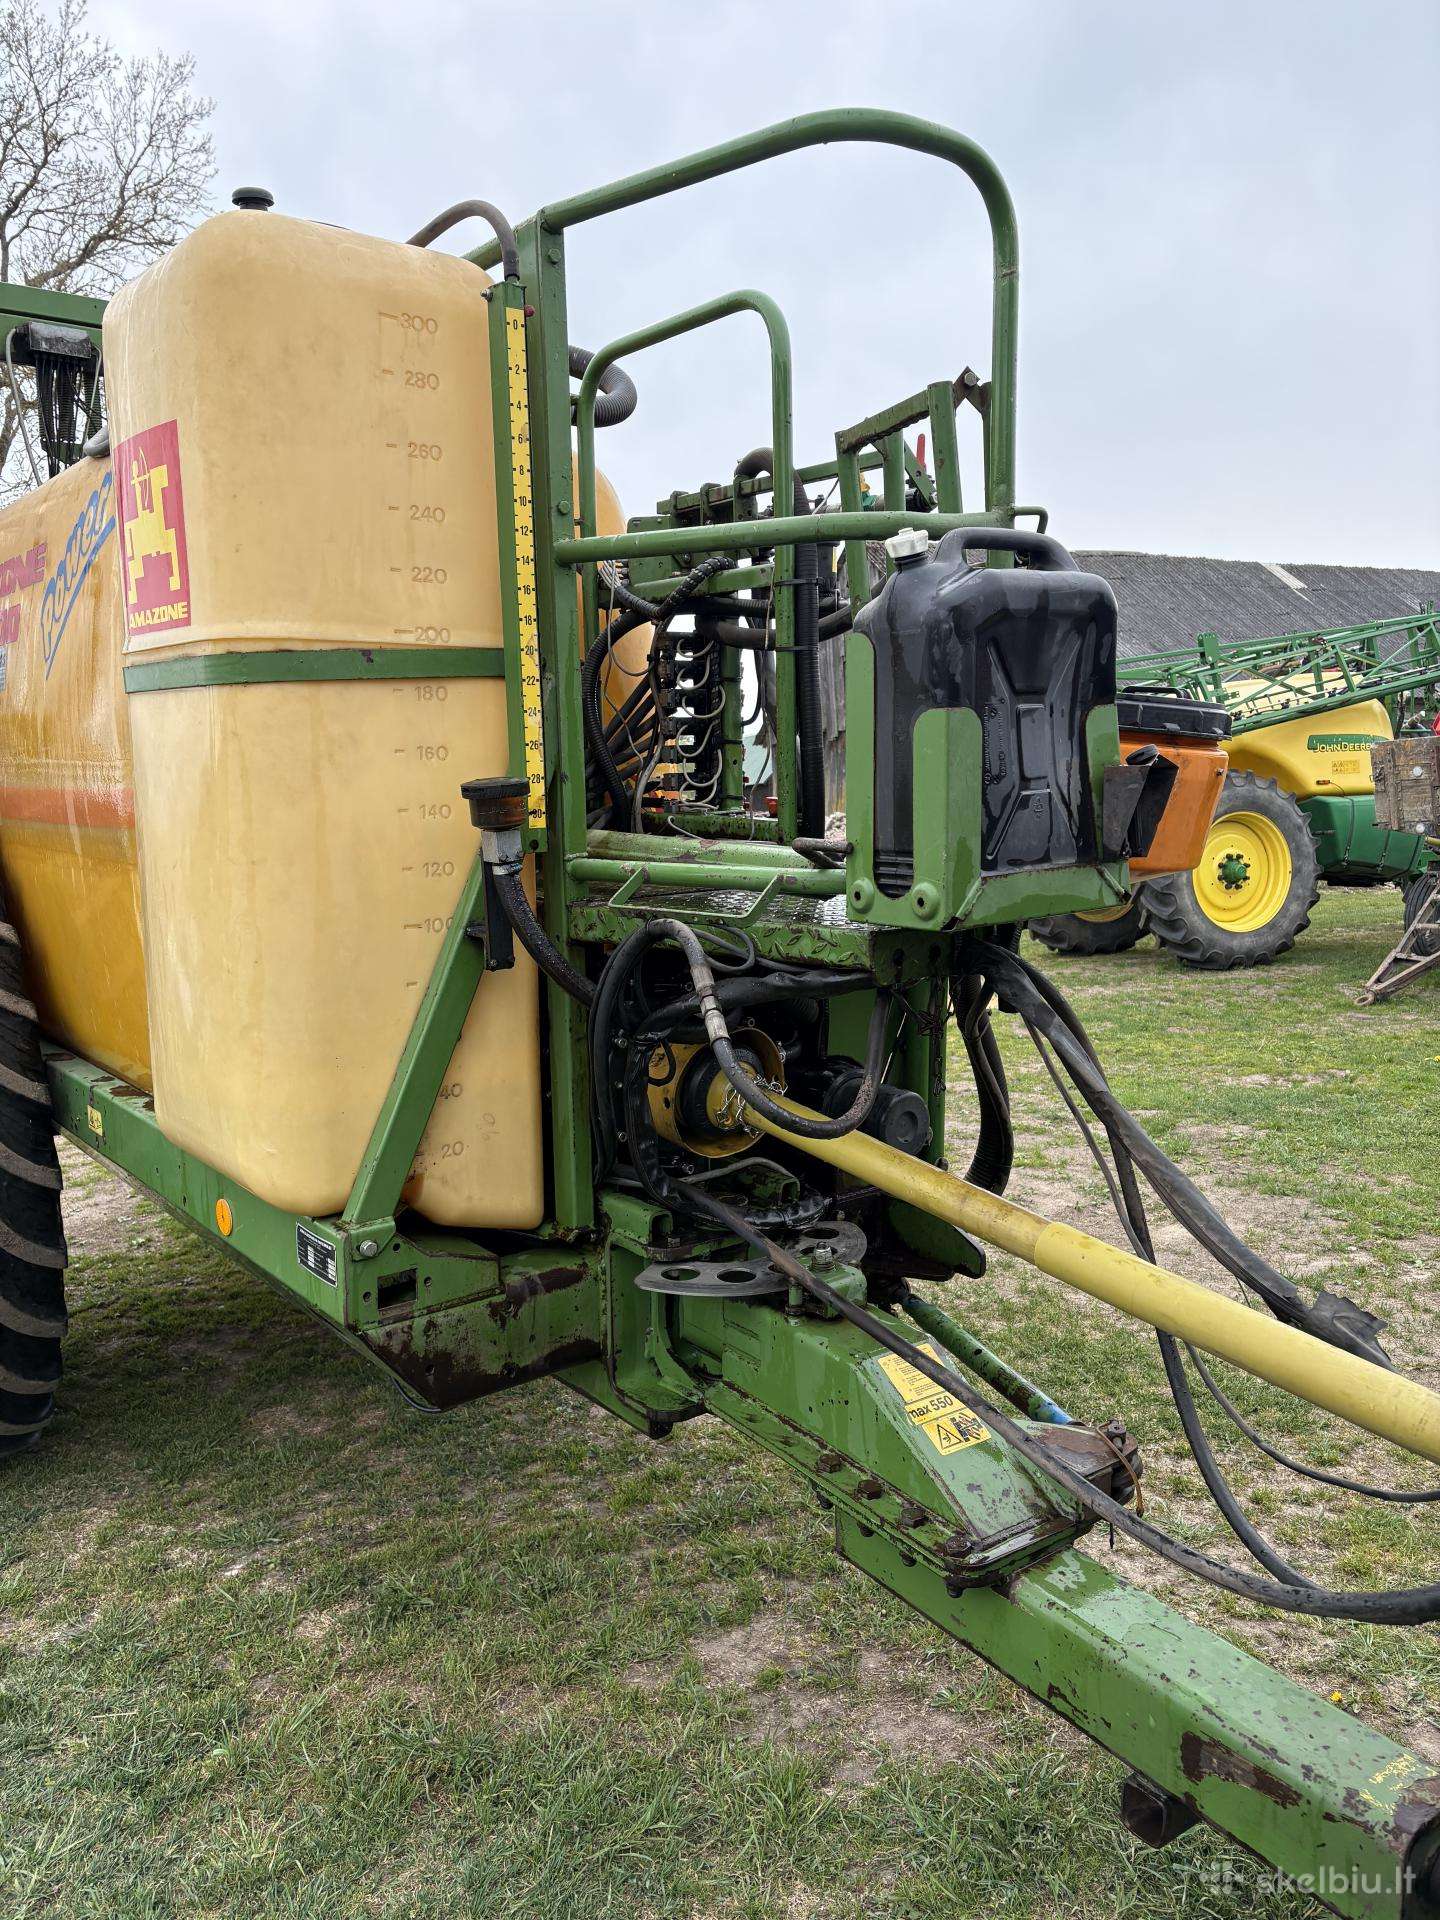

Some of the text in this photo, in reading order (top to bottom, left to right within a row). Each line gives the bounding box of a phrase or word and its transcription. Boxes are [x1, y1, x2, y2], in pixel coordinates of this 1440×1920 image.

[400, 312, 438, 335] 300
[512, 319, 518, 330] 0
[515, 364, 520, 375] 2
[404, 370, 440, 391] 280
[516, 400, 522, 411] 4
[518, 433, 523, 444] 6
[407, 441, 442, 461] 260
[519, 465, 524, 476] 8
[518, 495, 527, 507] 10
[409, 504, 446, 524] 240
[519, 525, 529, 536] 12
[521, 555, 530, 566] 14
[411, 566, 448, 585] 220
[522, 584, 531, 595] 16
[129, 601, 188, 628] AMAZONE
[524, 614, 533, 626] 18
[414, 626, 450, 643] 200
[524, 644, 534, 656] 20
[526, 675, 536, 686] 22
[414, 685, 449, 702] 180
[528, 706, 537, 717] 24
[529, 740, 539, 751] 26
[1314, 742, 1341, 752] JOHN
[416, 745, 449, 761] 160
[531, 773, 541, 784] 28
[420, 804, 451, 820] 140
[422, 861, 454, 877] 120
[441, 1141, 464, 1159] 20
[930, 1395, 953, 1412] 550
